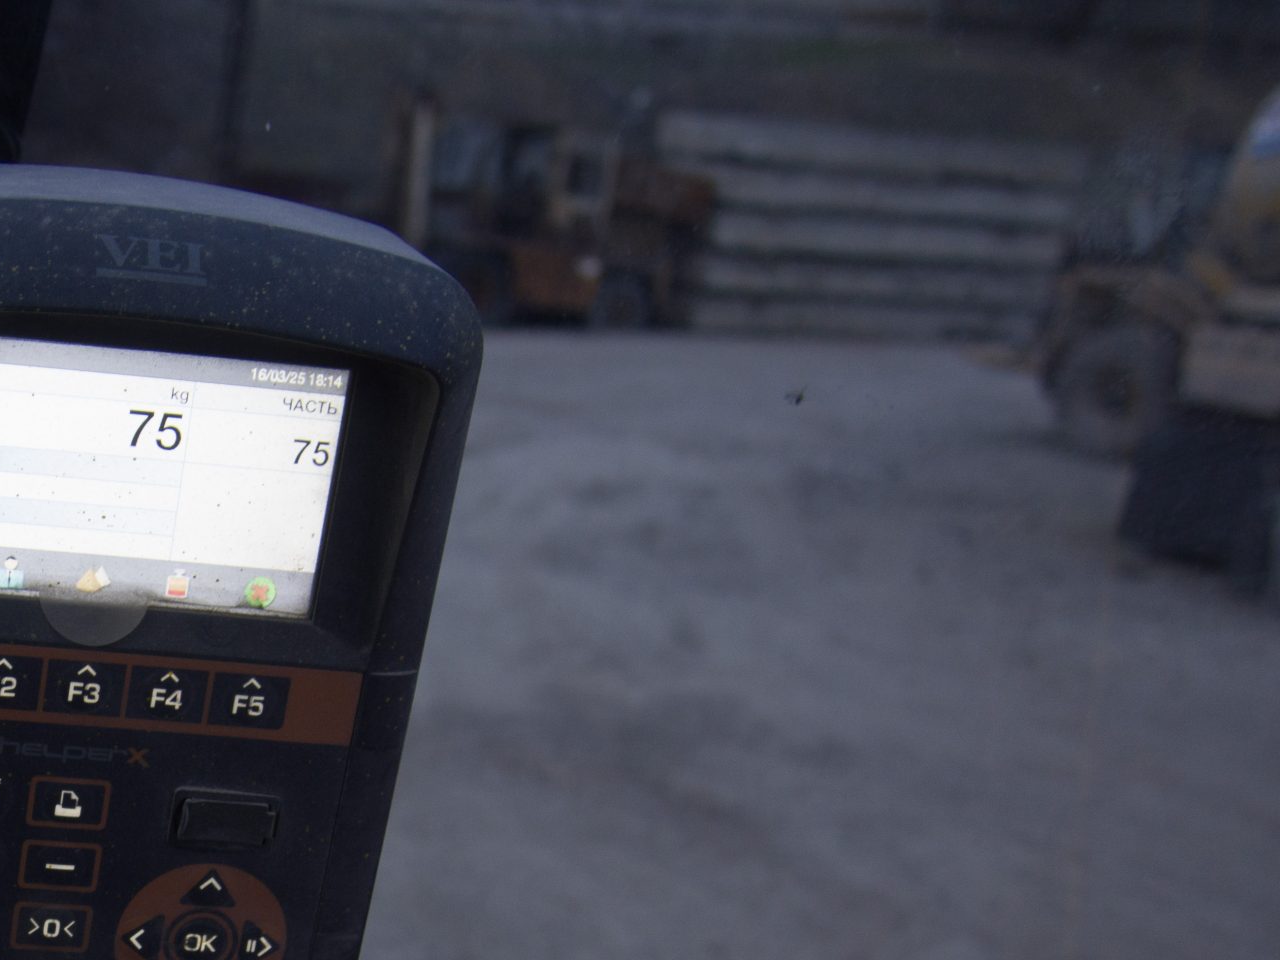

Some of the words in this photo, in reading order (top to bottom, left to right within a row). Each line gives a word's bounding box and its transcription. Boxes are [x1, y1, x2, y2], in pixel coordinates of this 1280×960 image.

[93, 233, 208, 276] VEI
[251, 367, 306, 385] 16/03/25
[308, 373, 343, 389] 18:14
[171, 387, 189, 404] kg
[283, 397, 338, 415] ЧАСТЬ
[129, 409, 183, 451] 75
[293, 439, 330, 467] 75
[67, 682, 101, 704] F3
[149, 688, 183, 710] F4
[231, 694, 265, 717] F5
[183, 933, 218, 953] OK
